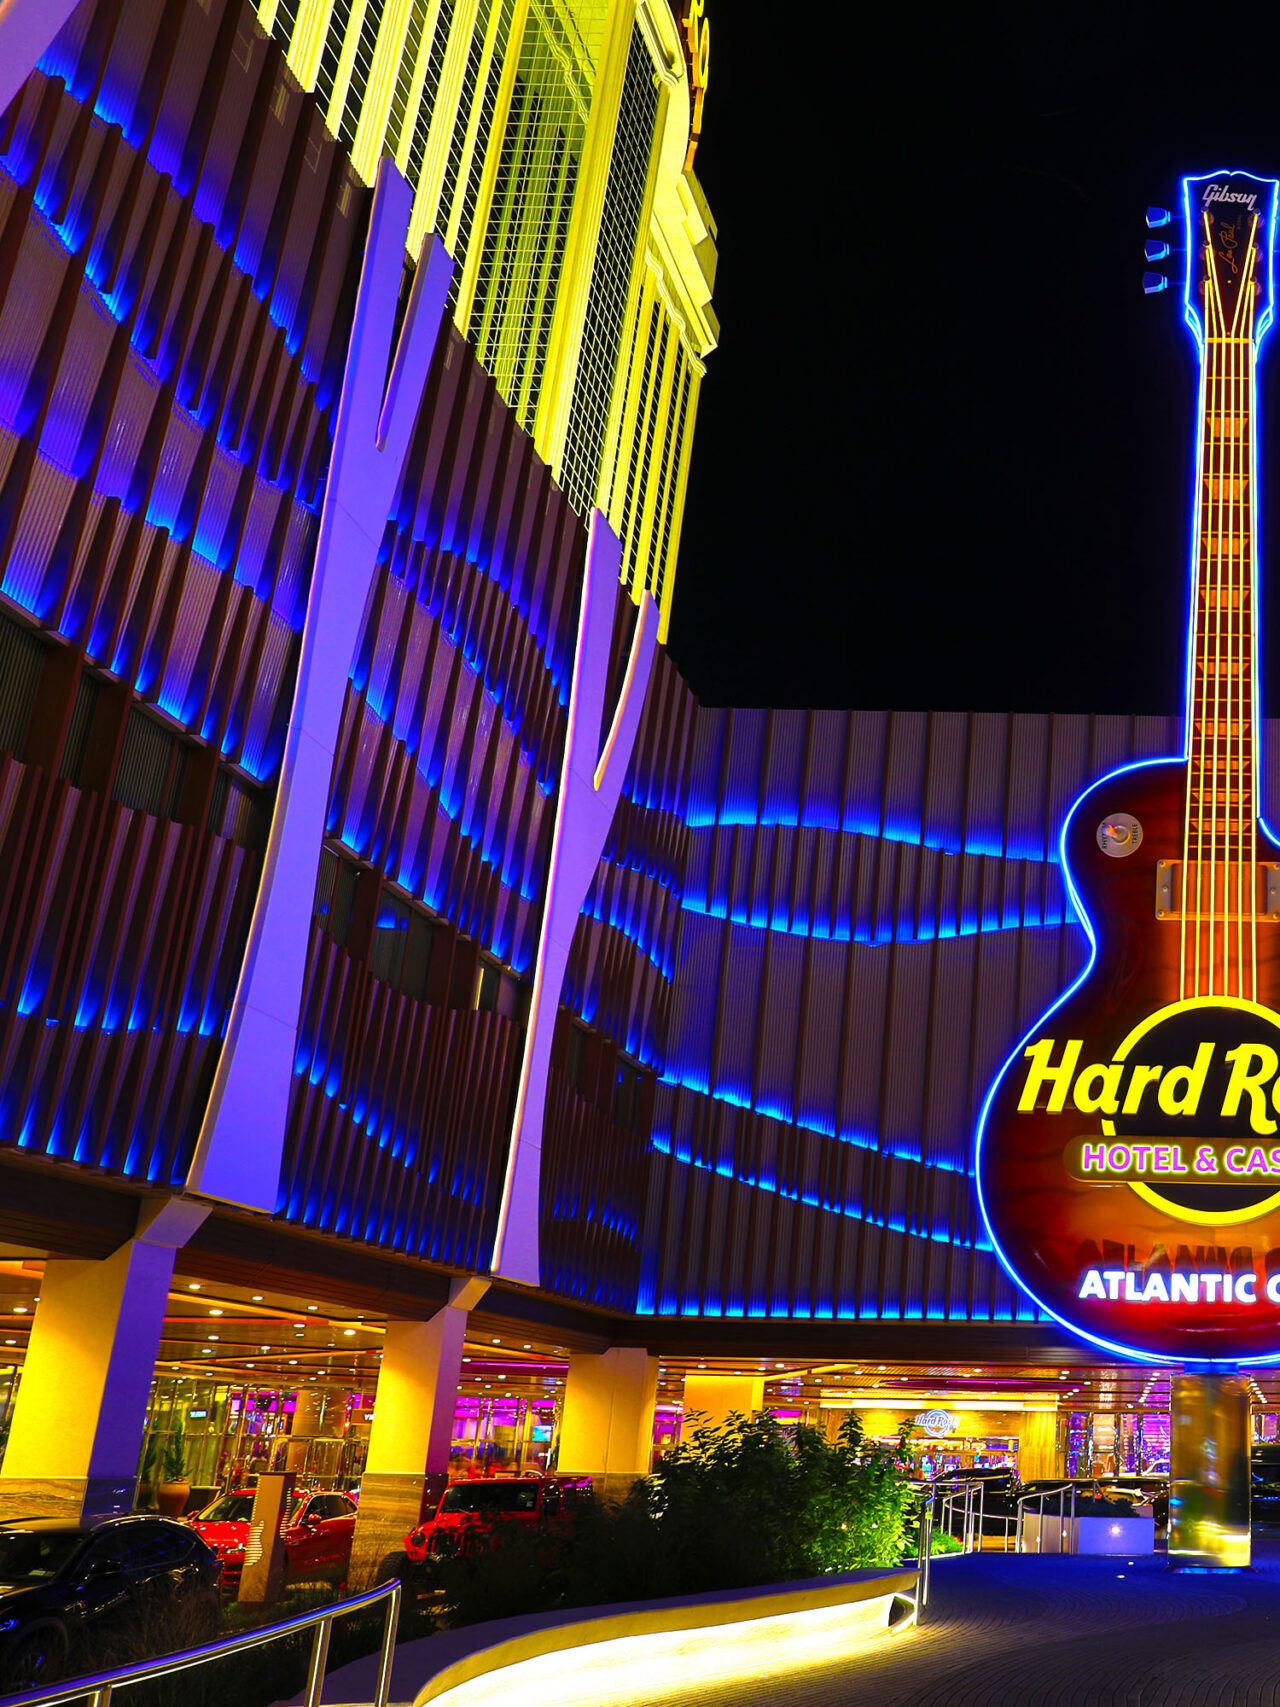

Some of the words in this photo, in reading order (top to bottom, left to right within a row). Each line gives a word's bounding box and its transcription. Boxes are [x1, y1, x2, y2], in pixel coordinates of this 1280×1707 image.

[1202, 184, 1257, 211] Gibson
[1017, 1039, 1215, 1115] Hard
[1081, 1143, 1188, 1174] HOTEL
[1194, 1147, 1218, 1174] &
[1078, 1269, 1257, 1303] ATLANTIC
[915, 1413, 937, 1426] Hard
